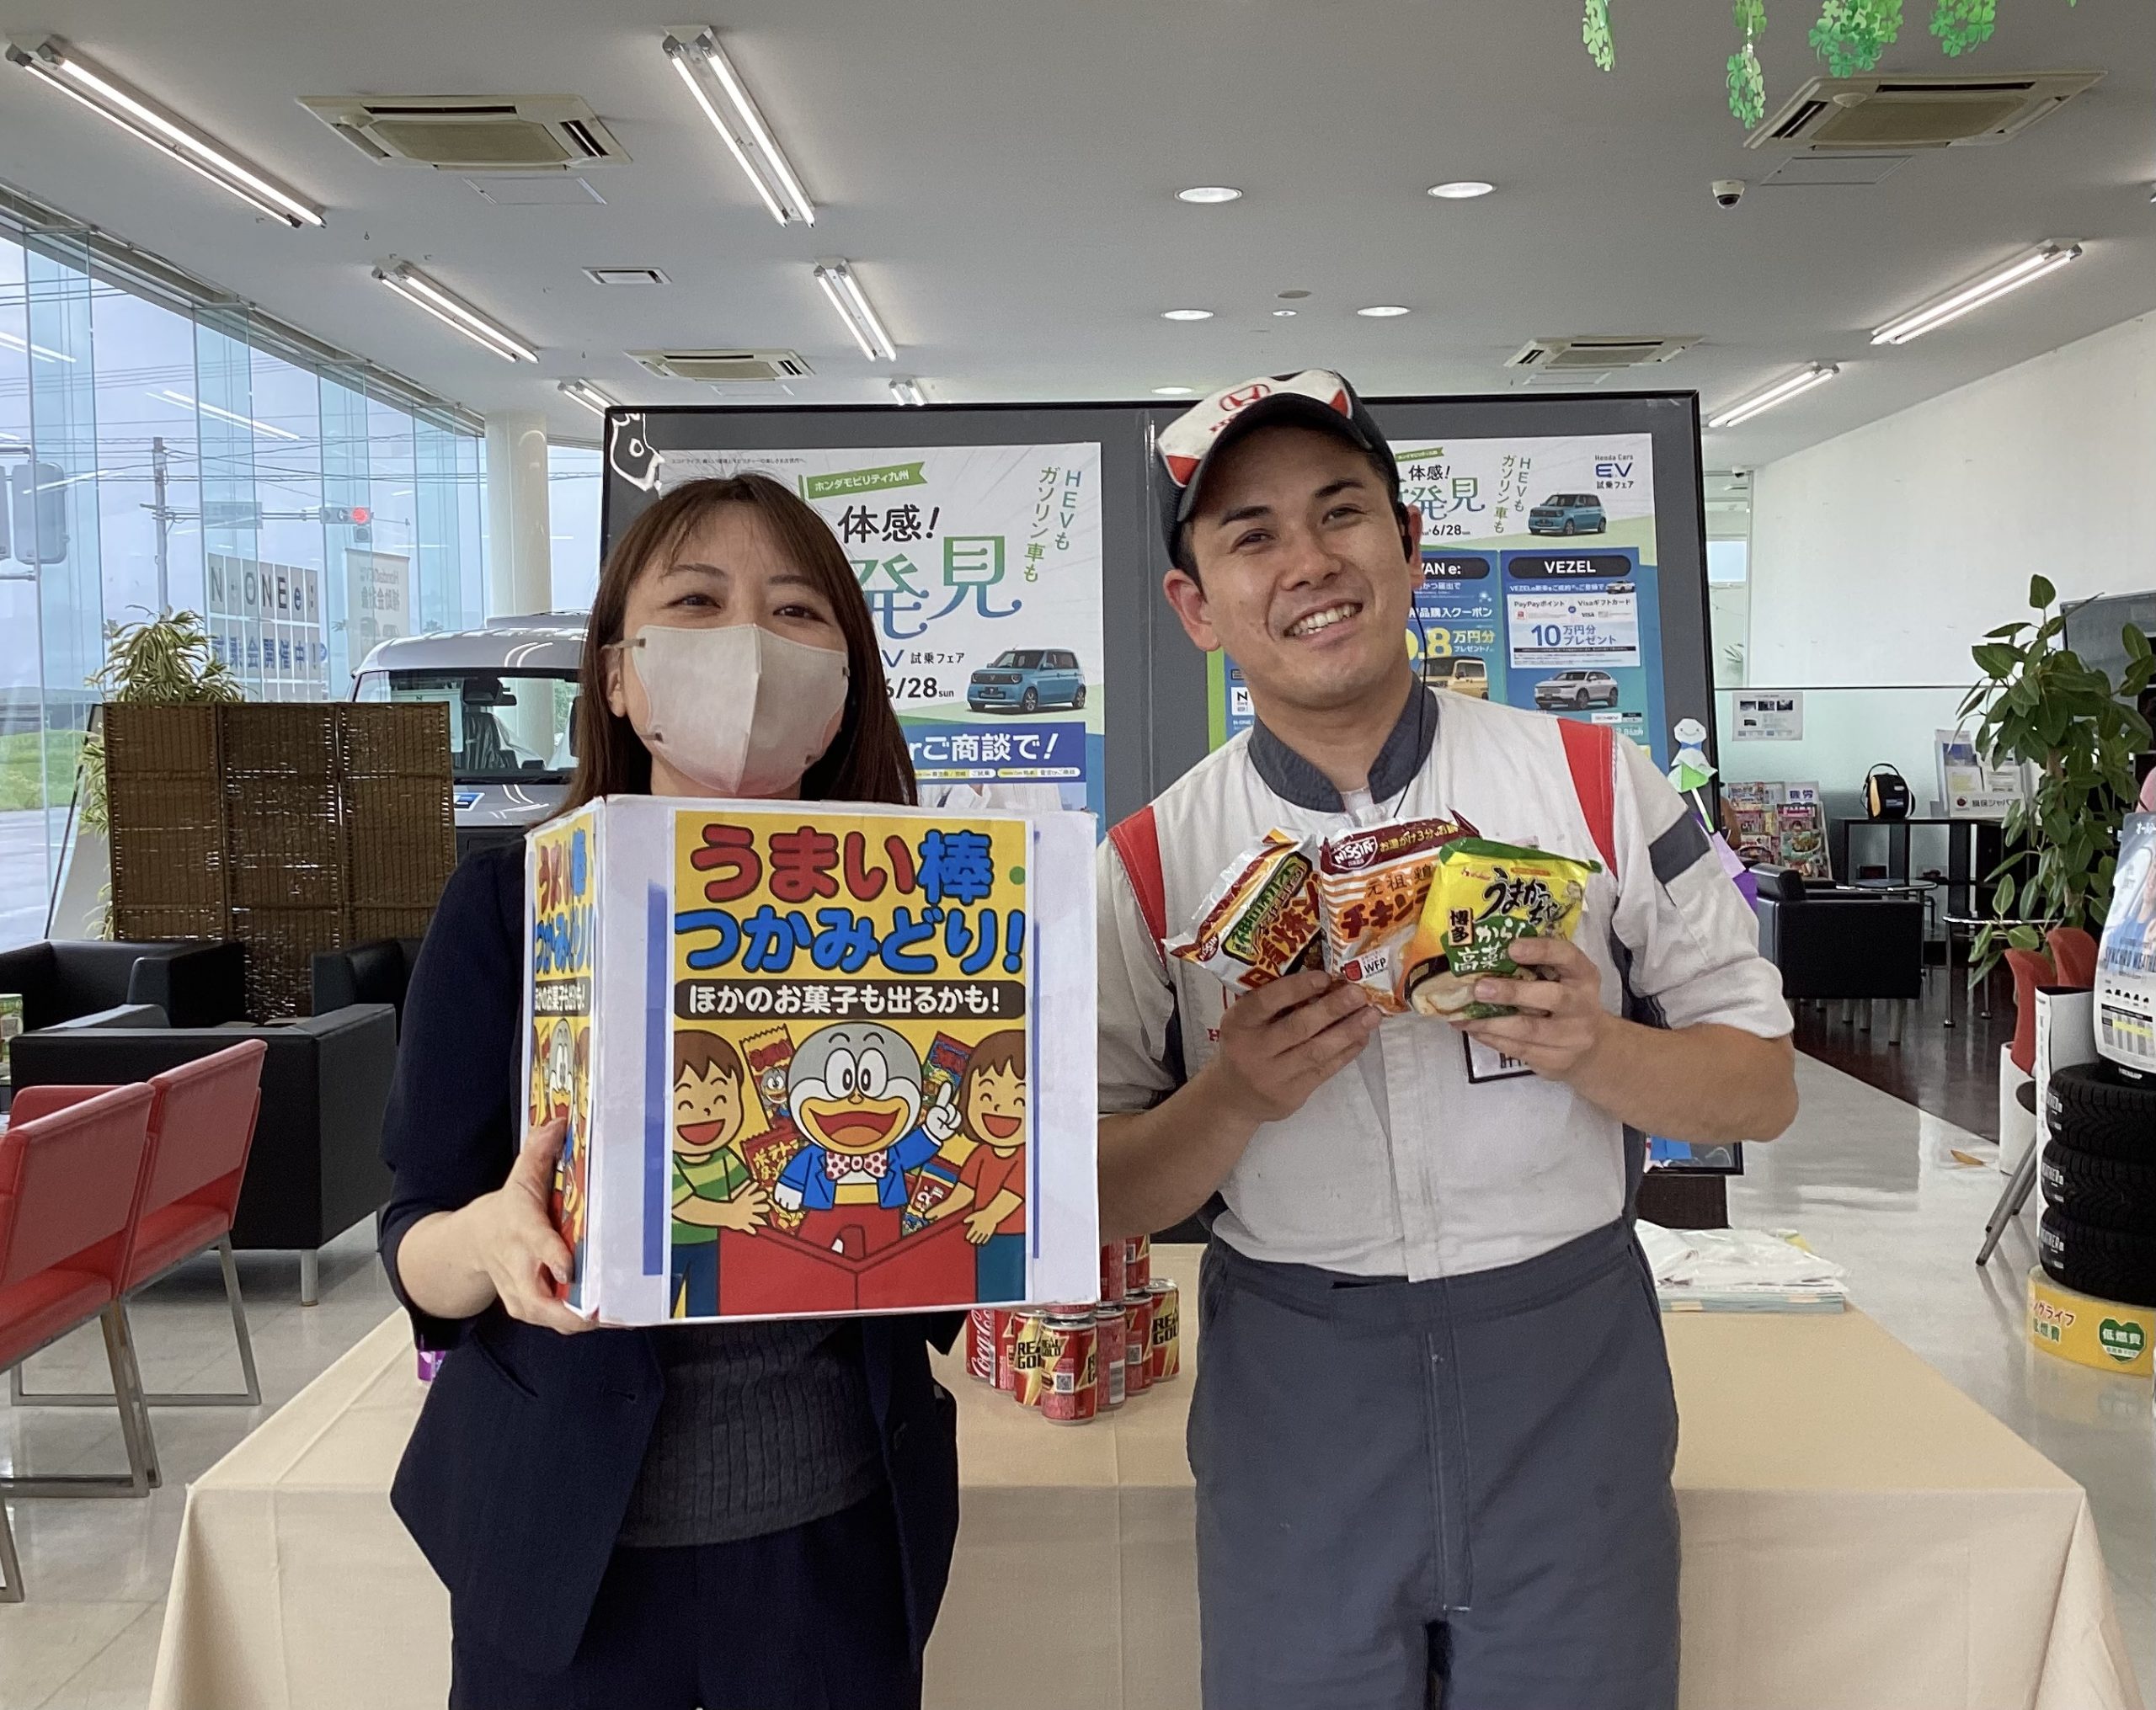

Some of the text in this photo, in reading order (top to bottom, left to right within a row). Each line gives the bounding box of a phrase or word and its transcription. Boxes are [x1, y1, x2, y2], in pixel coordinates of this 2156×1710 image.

[814, 469, 910, 492] ホンダモビリティ九州
[1595, 462, 1632, 477] EV
[1493, 455, 1515, 534] ガソリン車も
[1514, 457, 1530, 512] HEVも
[837, 503, 941, 544] 体感!
[1023, 466, 1060, 583] ガソリン車も
[1054, 470, 1081, 551] HEVも
[1545, 561, 1597, 573] VEZEL
[849, 535, 1022, 640] 発見
[1453, 630, 1495, 643] 万円分
[1531, 625, 1561, 646] 10
[1563, 625, 1596, 635] 万円分
[1564, 636, 1617, 646] プレゼント
[910, 653, 965, 664] 試乗フェア
[690, 823, 994, 904] うまい棒
[1334, 839, 1375, 866] NISSIN
[674, 904, 1027, 975] つかみどり!
[1449, 909, 1470, 943] 博多
[1364, 957, 1386, 974] WFP
[689, 984, 1000, 1015] ほかのお菓子も出るかも!
